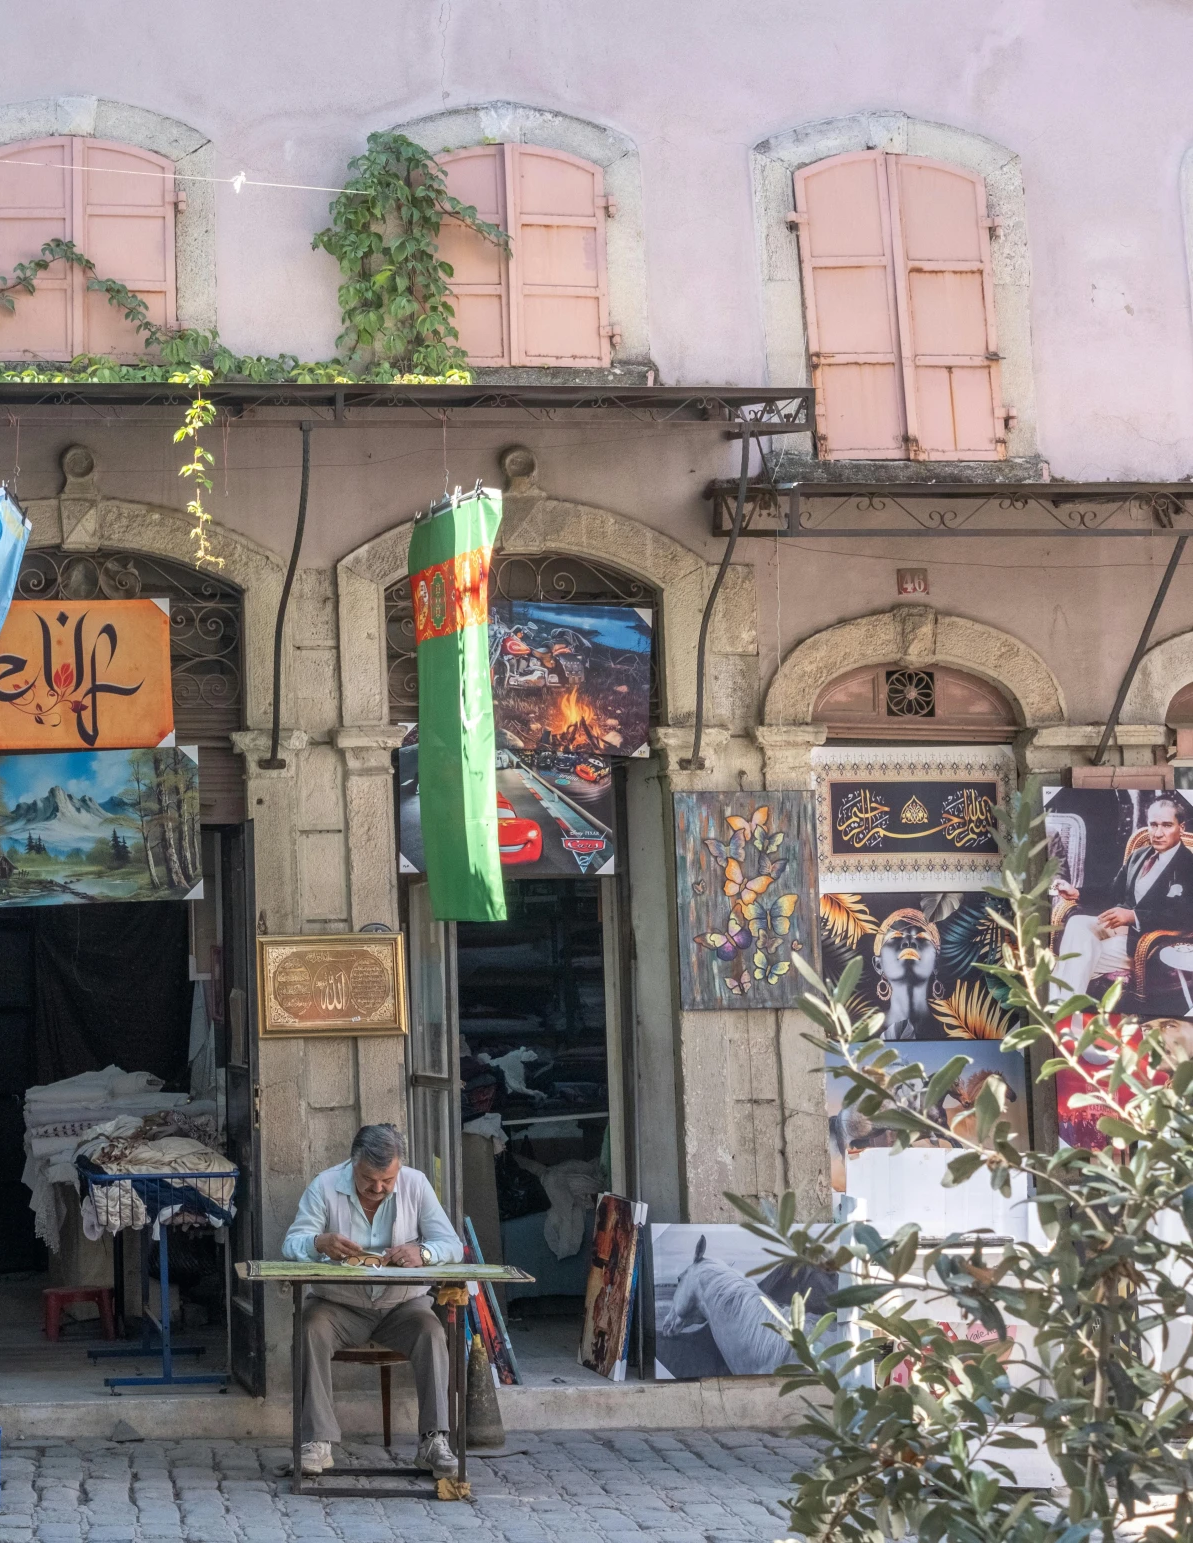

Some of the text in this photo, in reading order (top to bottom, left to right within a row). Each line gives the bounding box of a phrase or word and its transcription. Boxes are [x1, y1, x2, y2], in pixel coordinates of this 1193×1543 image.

[903, 571, 925, 592] 46
[567, 839, 599, 850] Cars
[579, 855, 590, 866] 2
